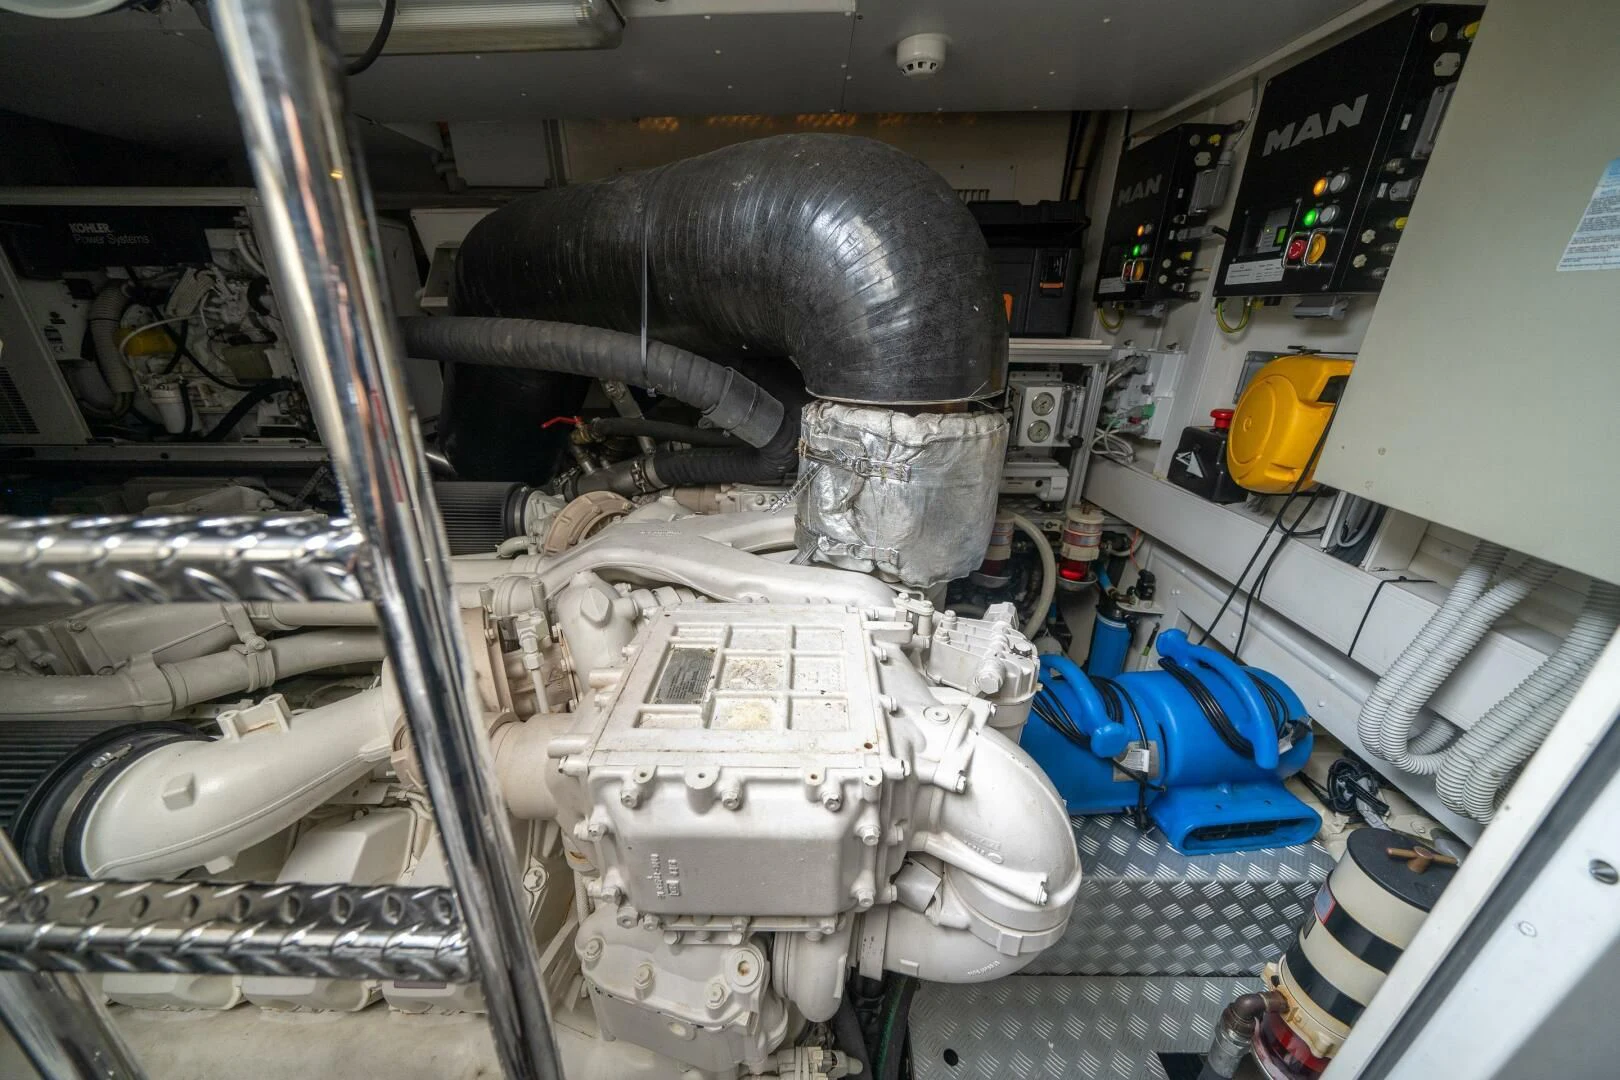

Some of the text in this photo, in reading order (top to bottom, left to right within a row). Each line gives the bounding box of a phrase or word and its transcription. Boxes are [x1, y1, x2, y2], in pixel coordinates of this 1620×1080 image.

[1263, 94, 1368, 157] MAN
[1117, 174, 1162, 207] MAN
[69, 223, 111, 232] KOHLER
[73, 234, 150, 246] Power Systems
